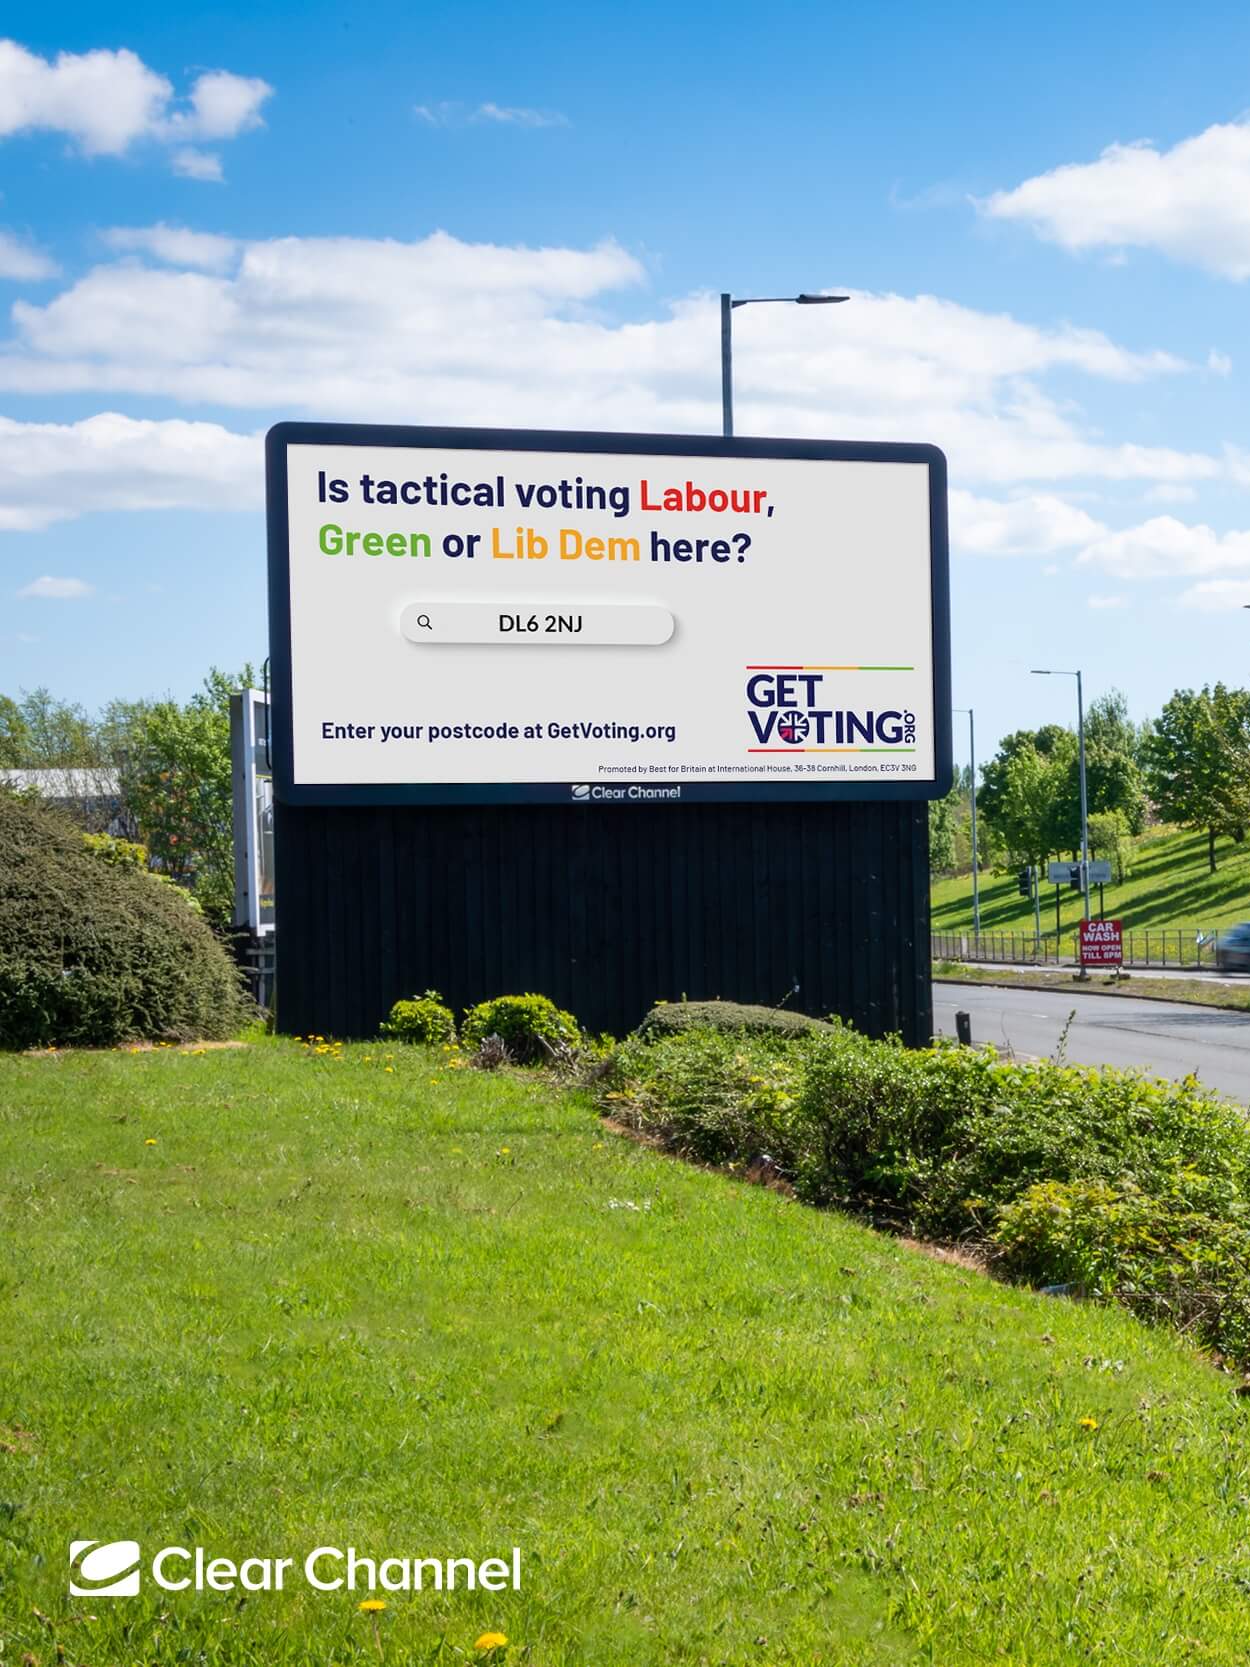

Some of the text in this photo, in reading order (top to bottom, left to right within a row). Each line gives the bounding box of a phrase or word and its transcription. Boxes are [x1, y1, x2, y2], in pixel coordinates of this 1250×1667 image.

[318, 471, 774, 517] Is tactical voting Labour,
[319, 523, 751, 563] Green or Lib Dem here?
[499, 614, 583, 633] DL6 2NJ
[746, 674, 823, 707] GET
[322, 722, 676, 743] Enter your postcode at GetVoting.org
[598, 765, 637, 773] Promoted
[638, 766, 647, 774] by
[649, 765, 667, 773] Best
[668, 765, 679, 773] for
[681, 765, 707, 773] Britain
[708, 765, 716, 773] at
[717, 764, 766, 773] International
[592, 786, 681, 799] Clear Channel
[1088, 922, 1114, 932] CAR
[1083, 932, 1120, 942] WASH
